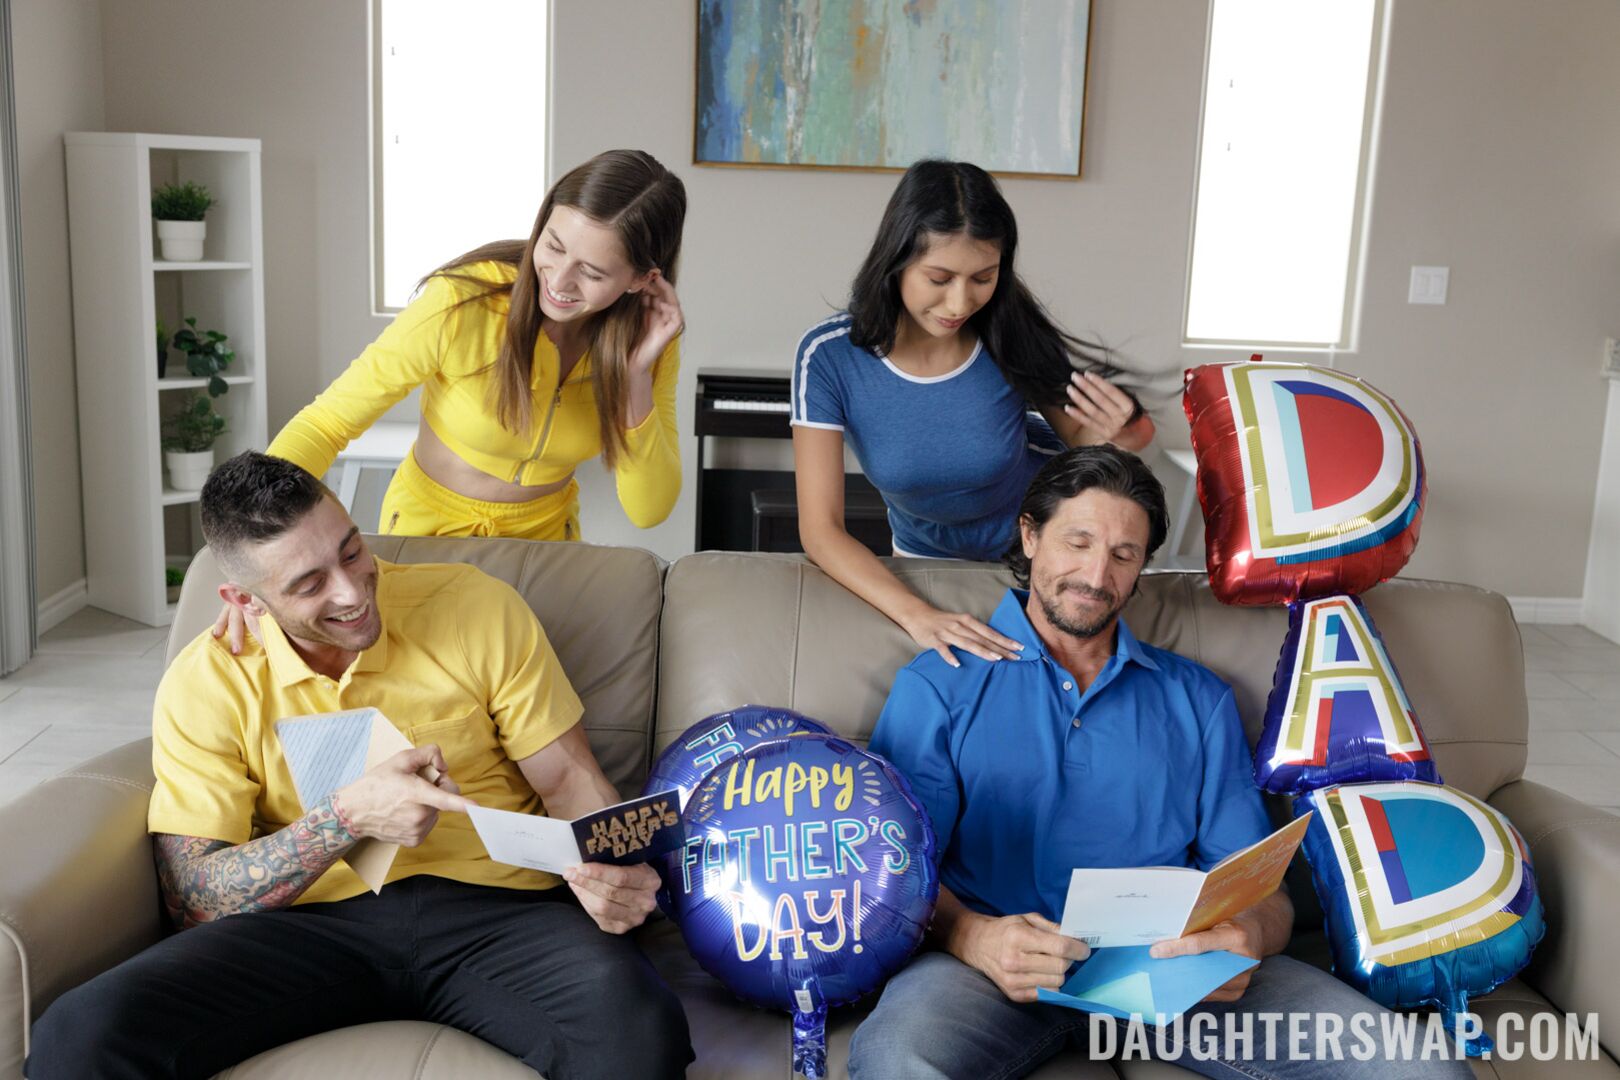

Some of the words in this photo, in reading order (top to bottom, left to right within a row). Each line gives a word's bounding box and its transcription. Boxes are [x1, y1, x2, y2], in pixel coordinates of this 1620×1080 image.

[1220, 361, 1528, 966] DAD
[592, 801, 668, 838] HAPPY
[723, 758, 854, 817] Happy
[612, 832, 654, 858] DAY
[682, 816, 911, 894] FATHER'S
[727, 879, 863, 961] DAY!
